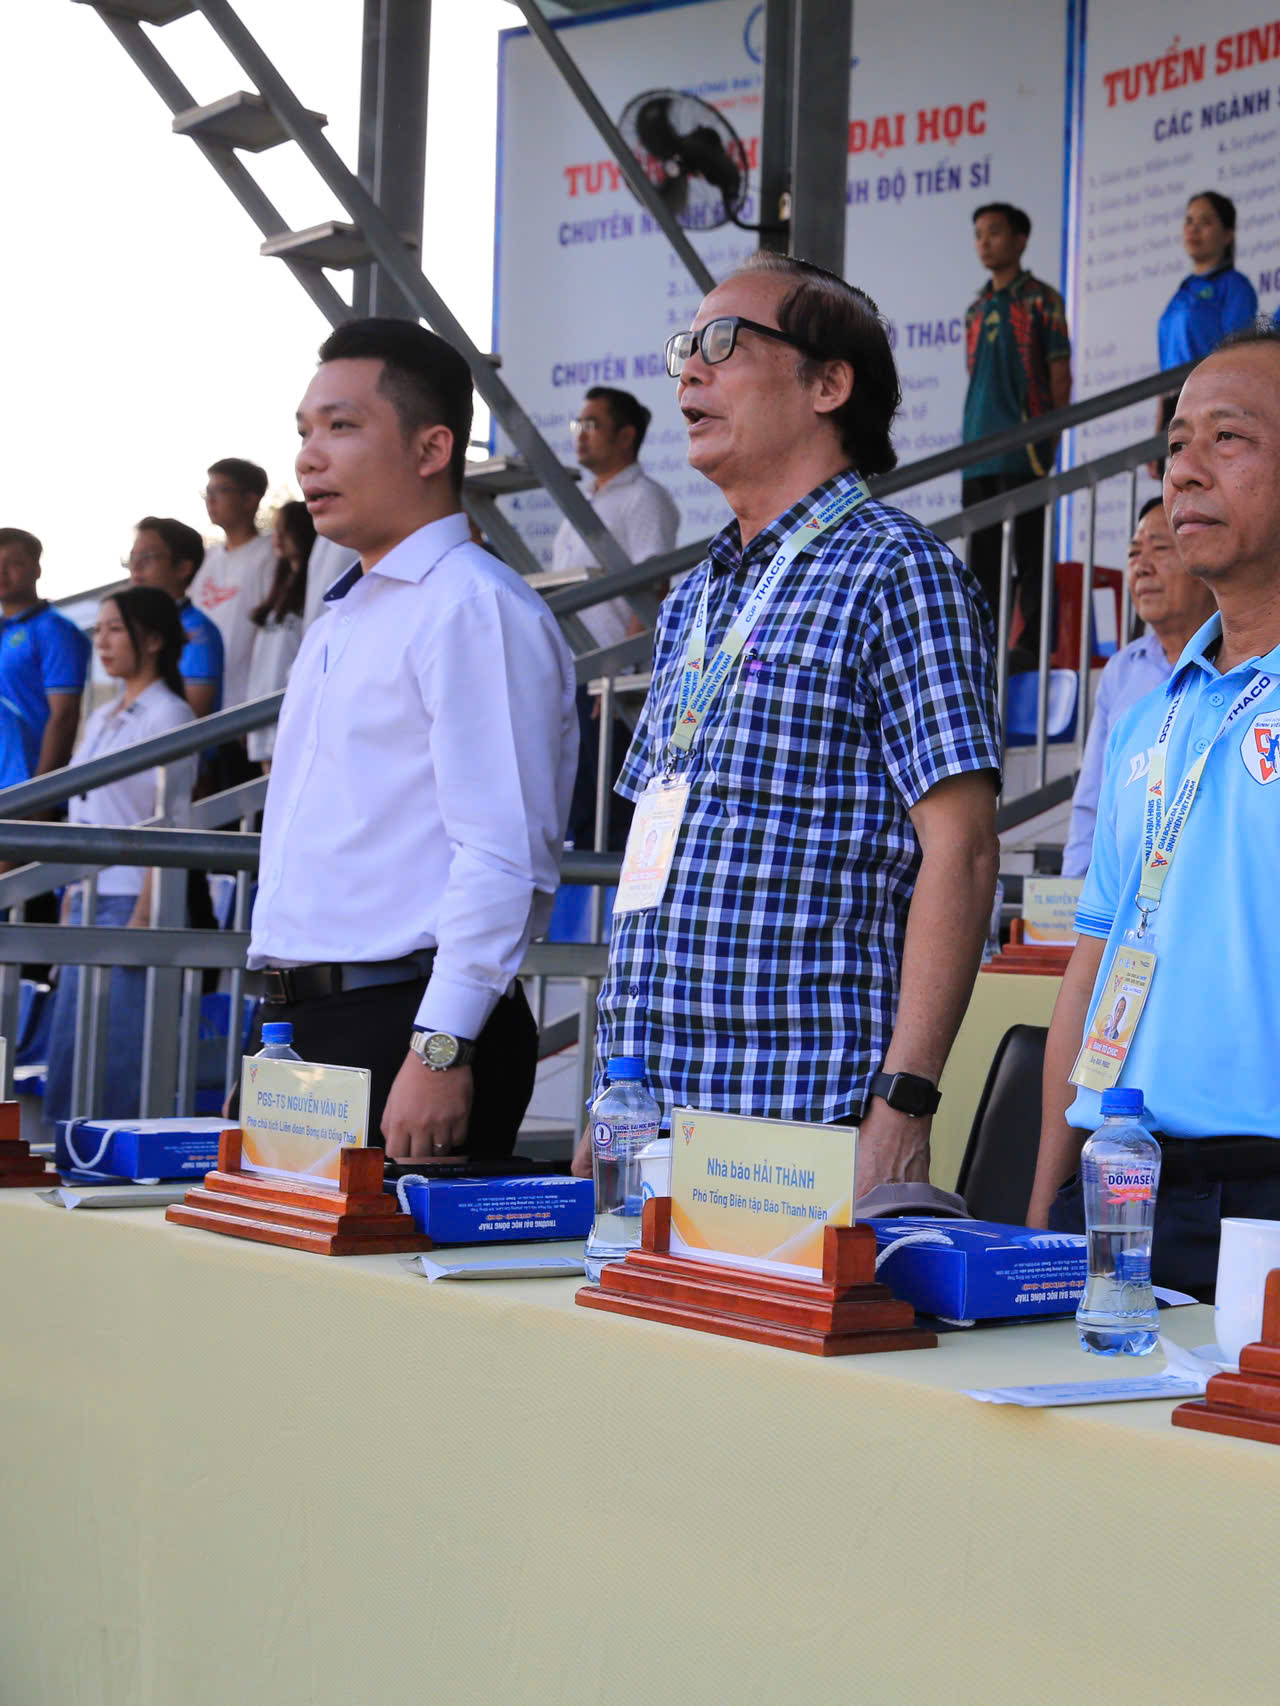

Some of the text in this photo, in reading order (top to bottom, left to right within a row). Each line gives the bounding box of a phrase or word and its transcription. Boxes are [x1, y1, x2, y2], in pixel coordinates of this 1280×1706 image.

[1103, 34, 1206, 107] TUYỂN
[917, 100, 986, 147] HỌC
[1154, 112, 1193, 142] CÁC
[755, 555, 786, 601] THACO
[1226, 676, 1271, 722] THACO
[1159, 700, 1180, 743] THACO
[257, 1091, 286, 1109] PGS-TS
[287, 1093, 319, 1117] NGUYỄN
[321, 1097, 336, 1116] VĂN
[707, 1157, 815, 1190] Nhà báo HẢI THÀNH
[692, 1188, 828, 1222] Phó Tổng Biên tập Báo Thanh Niên
